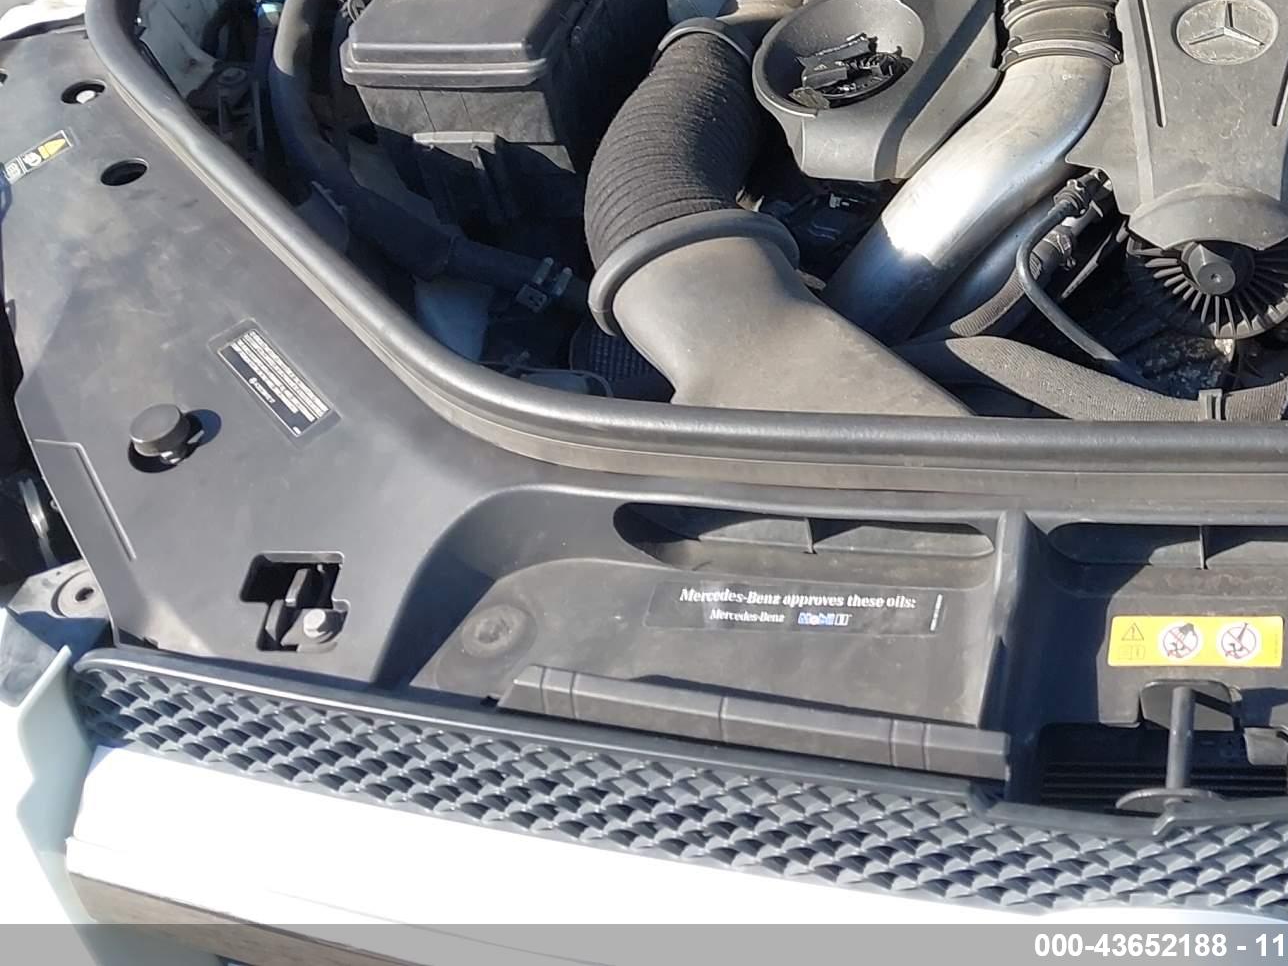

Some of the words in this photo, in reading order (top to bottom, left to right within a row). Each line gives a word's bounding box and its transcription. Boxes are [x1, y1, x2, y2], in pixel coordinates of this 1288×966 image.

[680, 588, 779, 605] Mercedes-Benz
[782, 594, 844, 608] approves
[847, 595, 884, 608] these
[886, 596, 916, 609] oils:
[709, 609, 785, 623] Mercedes-Benz
